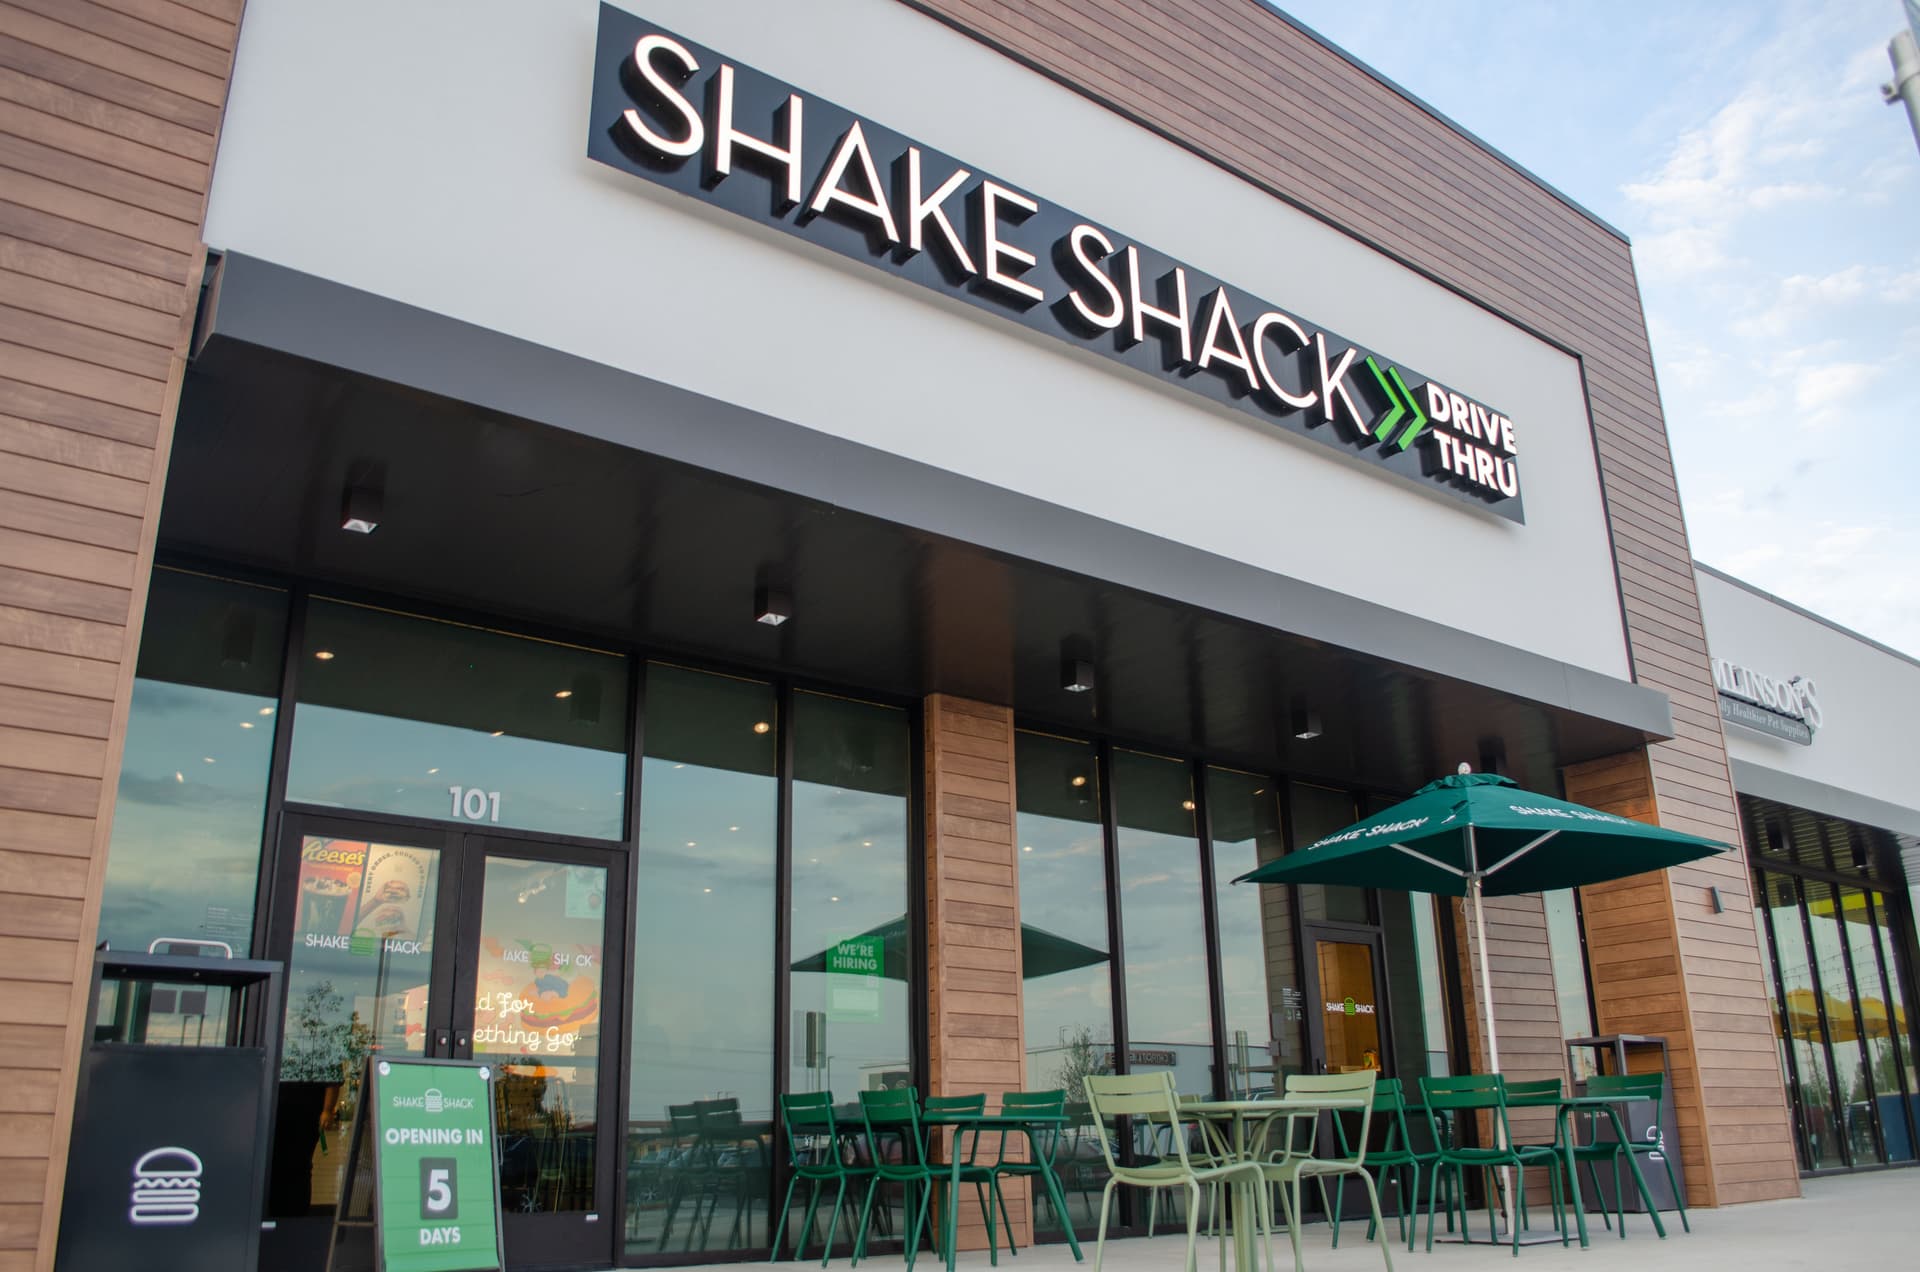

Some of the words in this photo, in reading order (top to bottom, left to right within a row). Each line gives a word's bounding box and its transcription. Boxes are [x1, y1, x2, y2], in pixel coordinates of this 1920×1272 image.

[624, 34, 1044, 301] SHAKE
[1069, 224, 1369, 436] SHACK
[1425, 381, 1517, 456] DRIVE
[1433, 429, 1517, 498] THRU
[448, 786, 501, 822] 101
[1366, 817, 1429, 837] SHACK
[302, 840, 366, 866] Reese's
[305, 933, 350, 949] SHAKE
[384, 938, 421, 955] HACK
[837, 944, 874, 957] WE'RE
[503, 950, 529, 963] AKE
[553, 952, 593, 967] SHCK
[833, 957, 878, 970] HIRING
[546, 1026, 581, 1052] Go
[392, 1096, 425, 1108] SHAKE
[443, 1097, 474, 1109] SHACK
[385, 1128, 462, 1145] OPENING
[466, 1129, 484, 1145] IN
[427, 1168, 452, 1213] 5
[420, 1226, 461, 1246] DAYS
